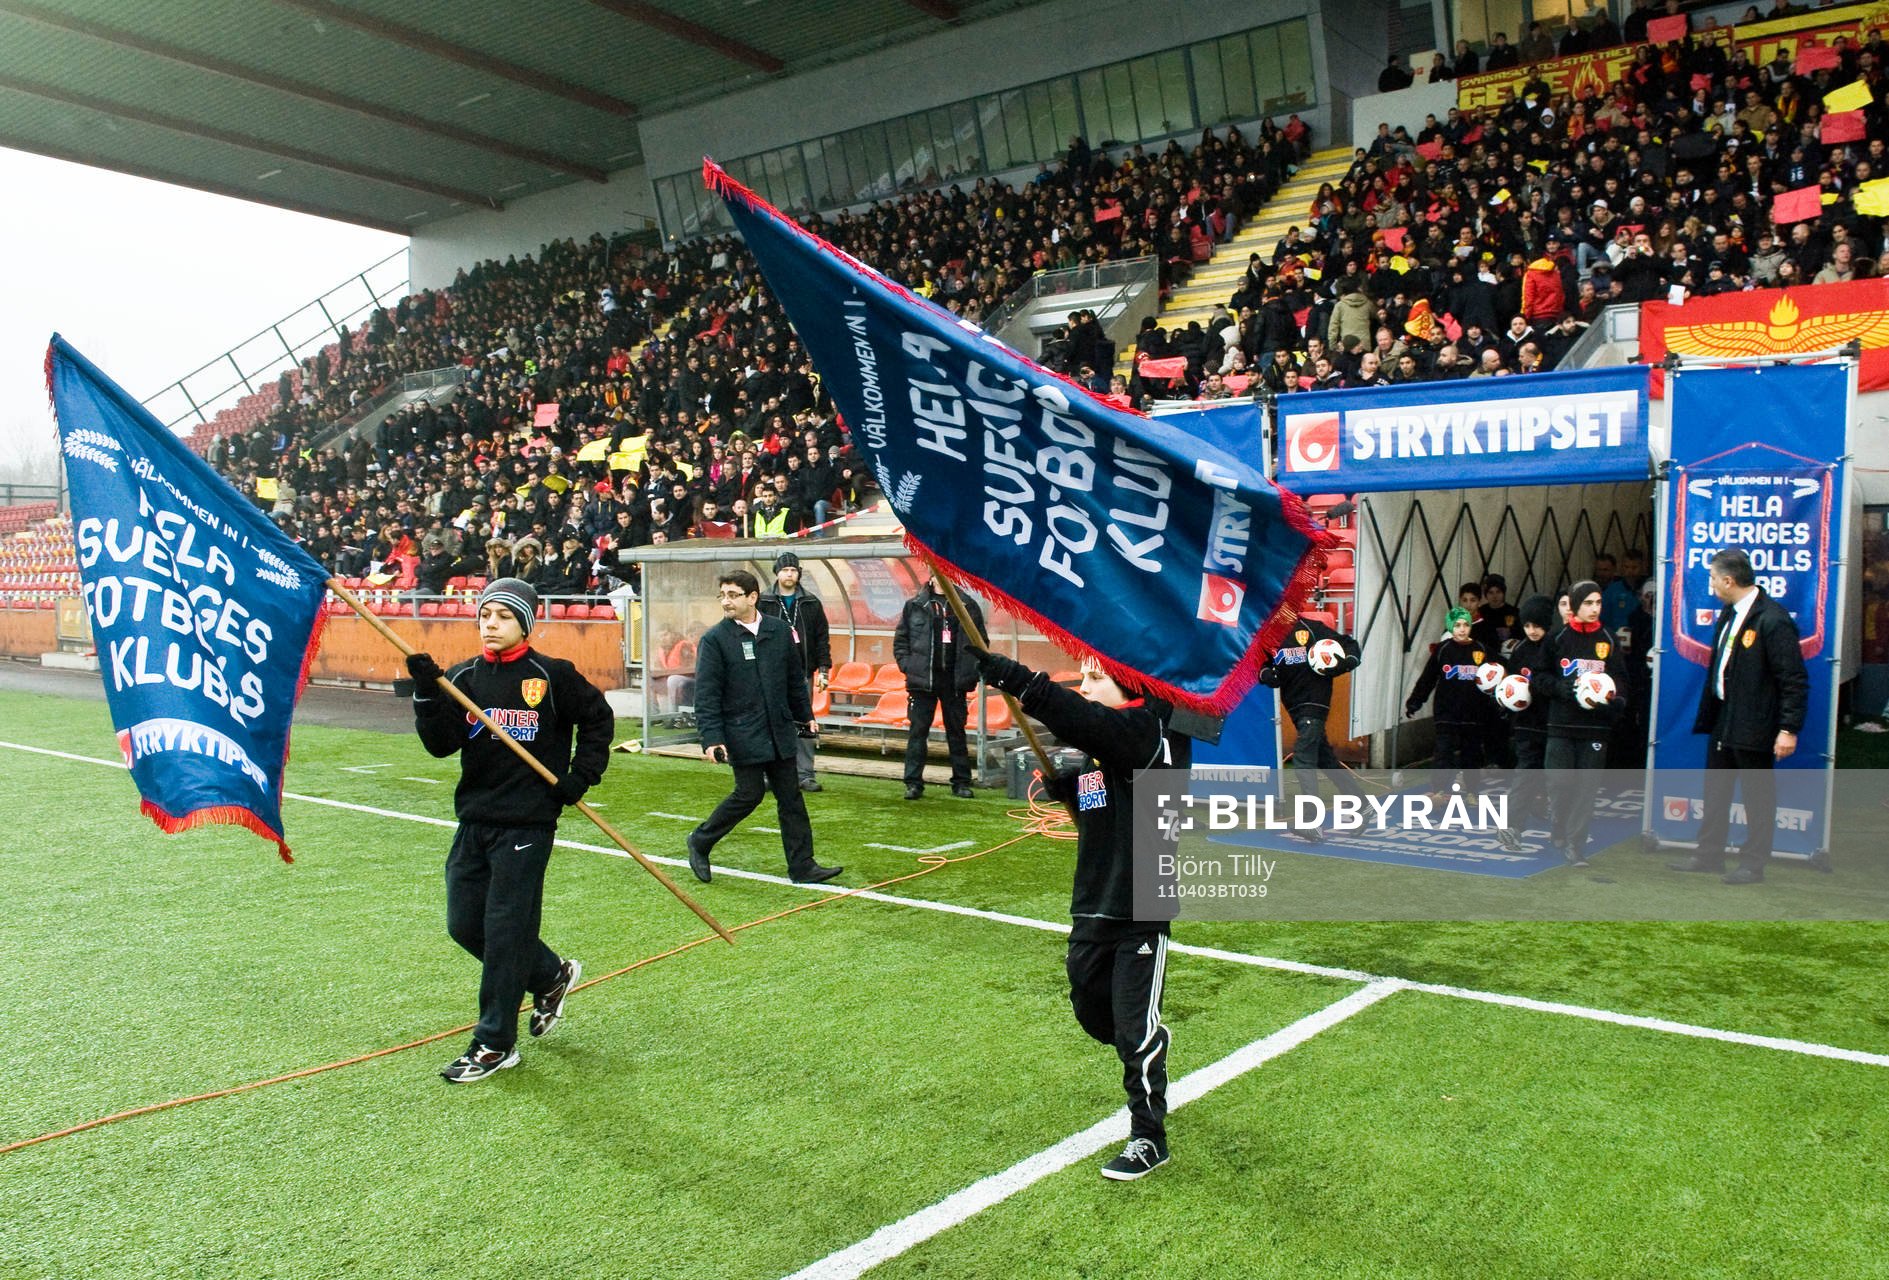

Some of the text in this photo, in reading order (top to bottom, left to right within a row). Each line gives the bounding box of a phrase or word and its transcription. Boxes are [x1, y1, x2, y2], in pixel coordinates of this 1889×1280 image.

[843, 315, 867, 336] IN
[851, 335, 888, 449] VÄLKOMMEN
[1353, 400, 1629, 461] STRYKTIPSET
[1717, 475, 1772, 486] VÄLKOMMEN
[1773, 476, 1784, 485] IN
[1105, 436, 1173, 574] KLU
[1720, 495, 1783, 518] HELA
[223, 523, 239, 542] IN
[1692, 522, 1811, 545] SVERIGES
[1688, 548, 1812, 572] FOOLLS
[78, 517, 273, 665] SVEGES
[492, 708, 539, 726] INTER
